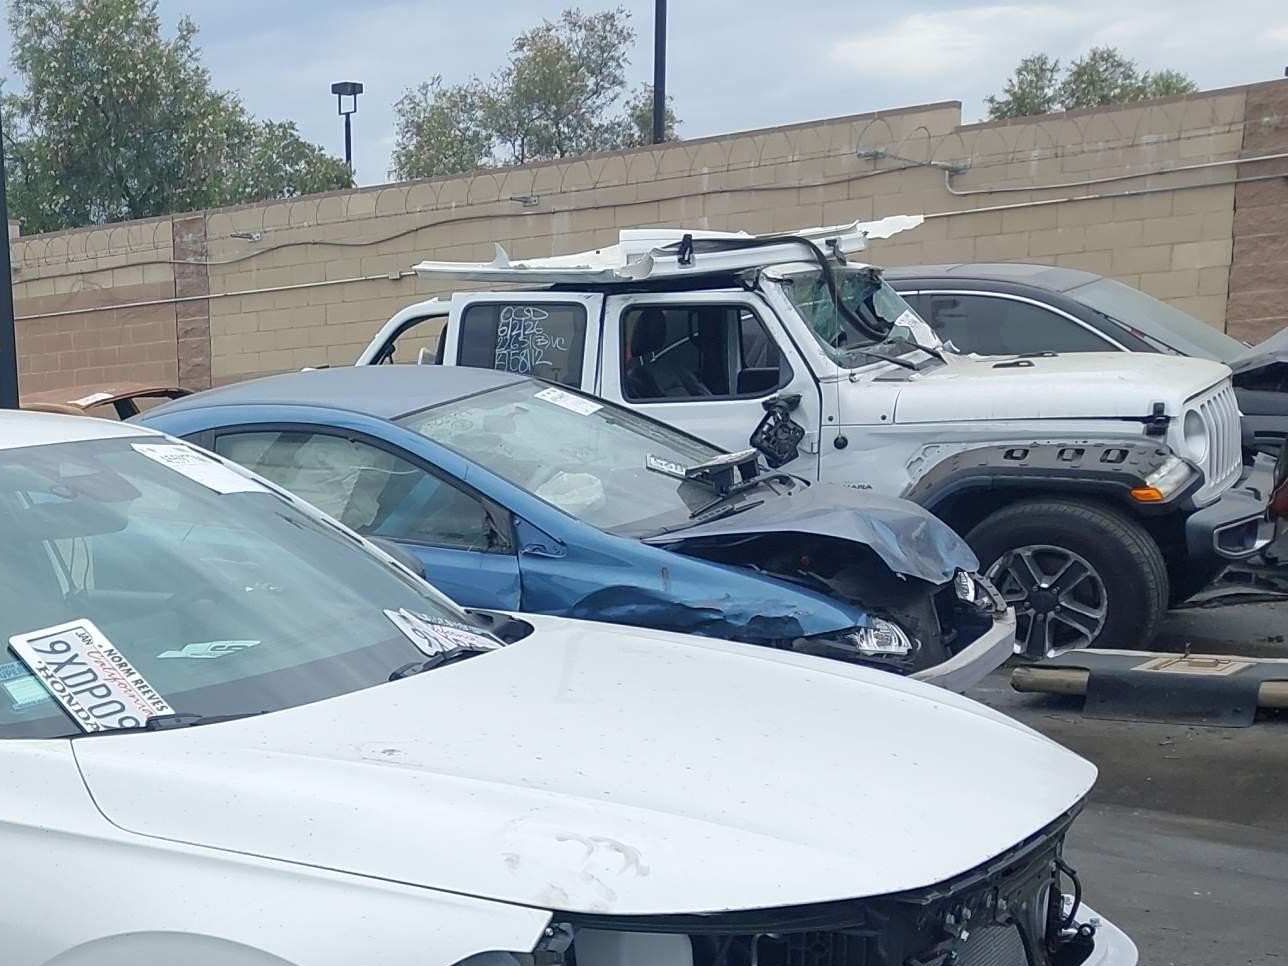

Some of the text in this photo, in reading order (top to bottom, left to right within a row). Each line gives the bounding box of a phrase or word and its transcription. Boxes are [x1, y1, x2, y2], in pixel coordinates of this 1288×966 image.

[75, 630, 94, 646] JAN
[37, 664, 101, 733] HONDA
[87, 650, 154, 717] California
[105, 648, 169, 712] NORM REEVES
